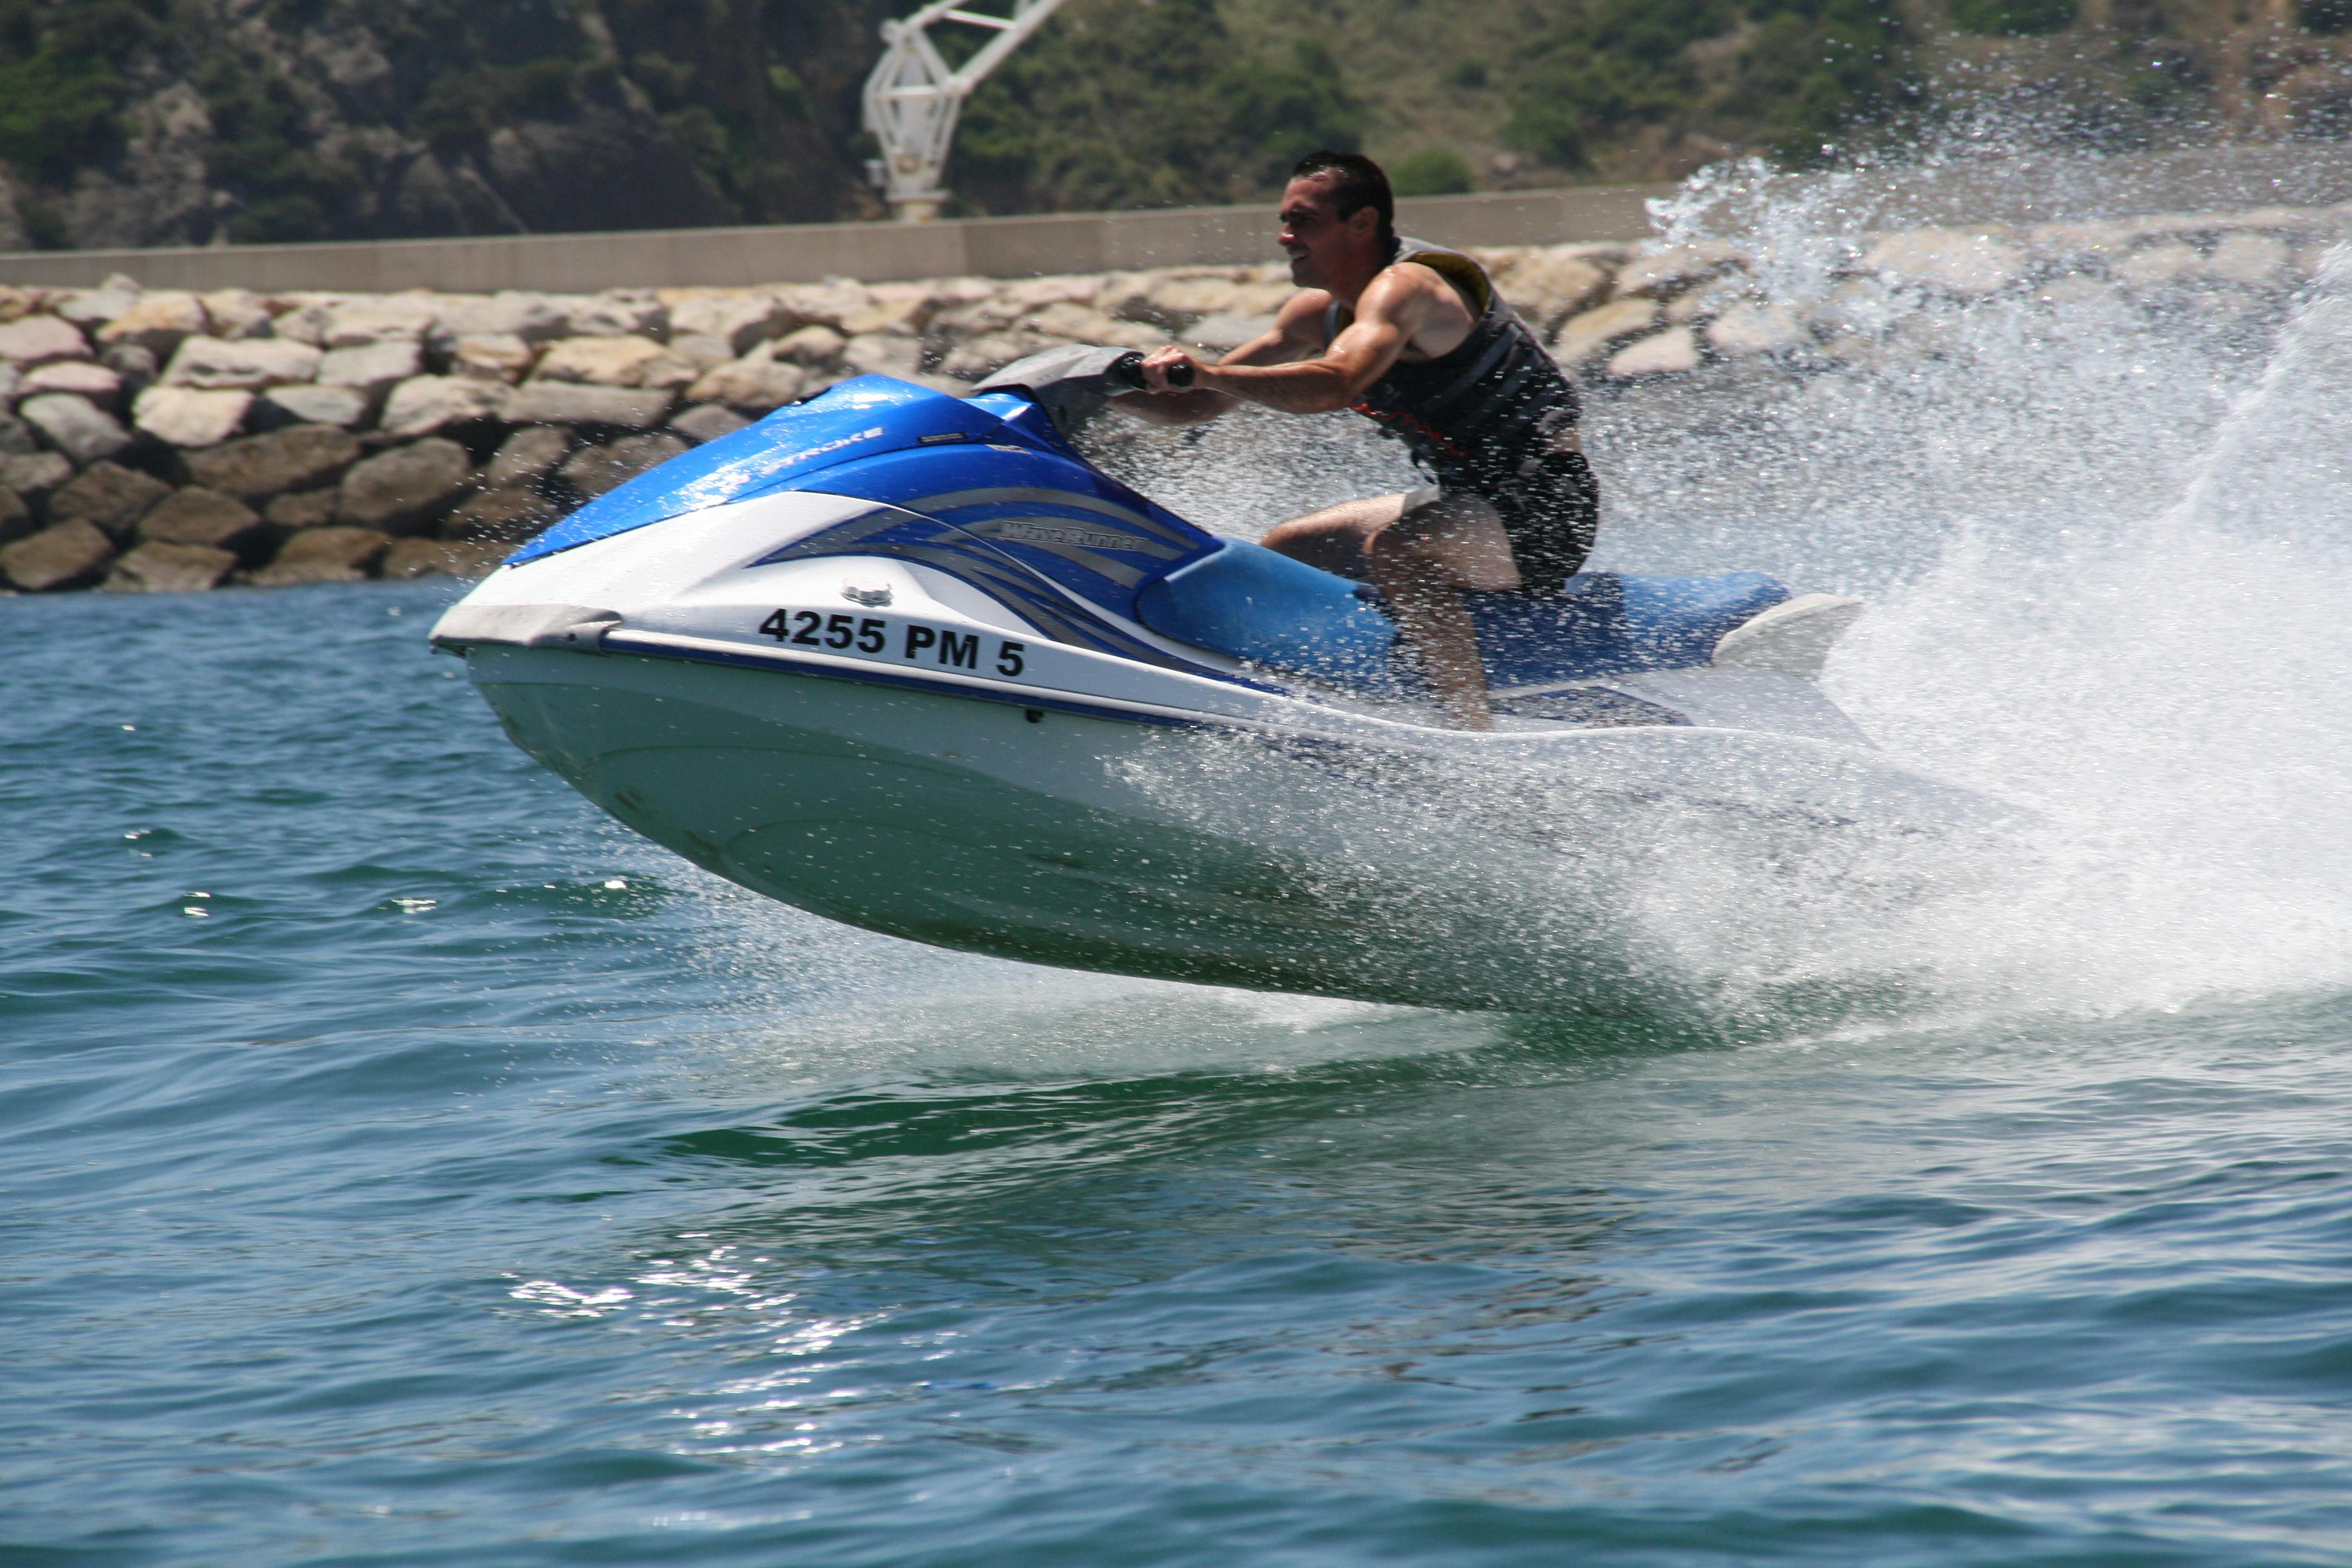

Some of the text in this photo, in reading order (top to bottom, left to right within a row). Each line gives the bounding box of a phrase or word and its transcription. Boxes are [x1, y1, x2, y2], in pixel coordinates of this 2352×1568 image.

[759, 608, 1025, 677] 4255 PM 5
